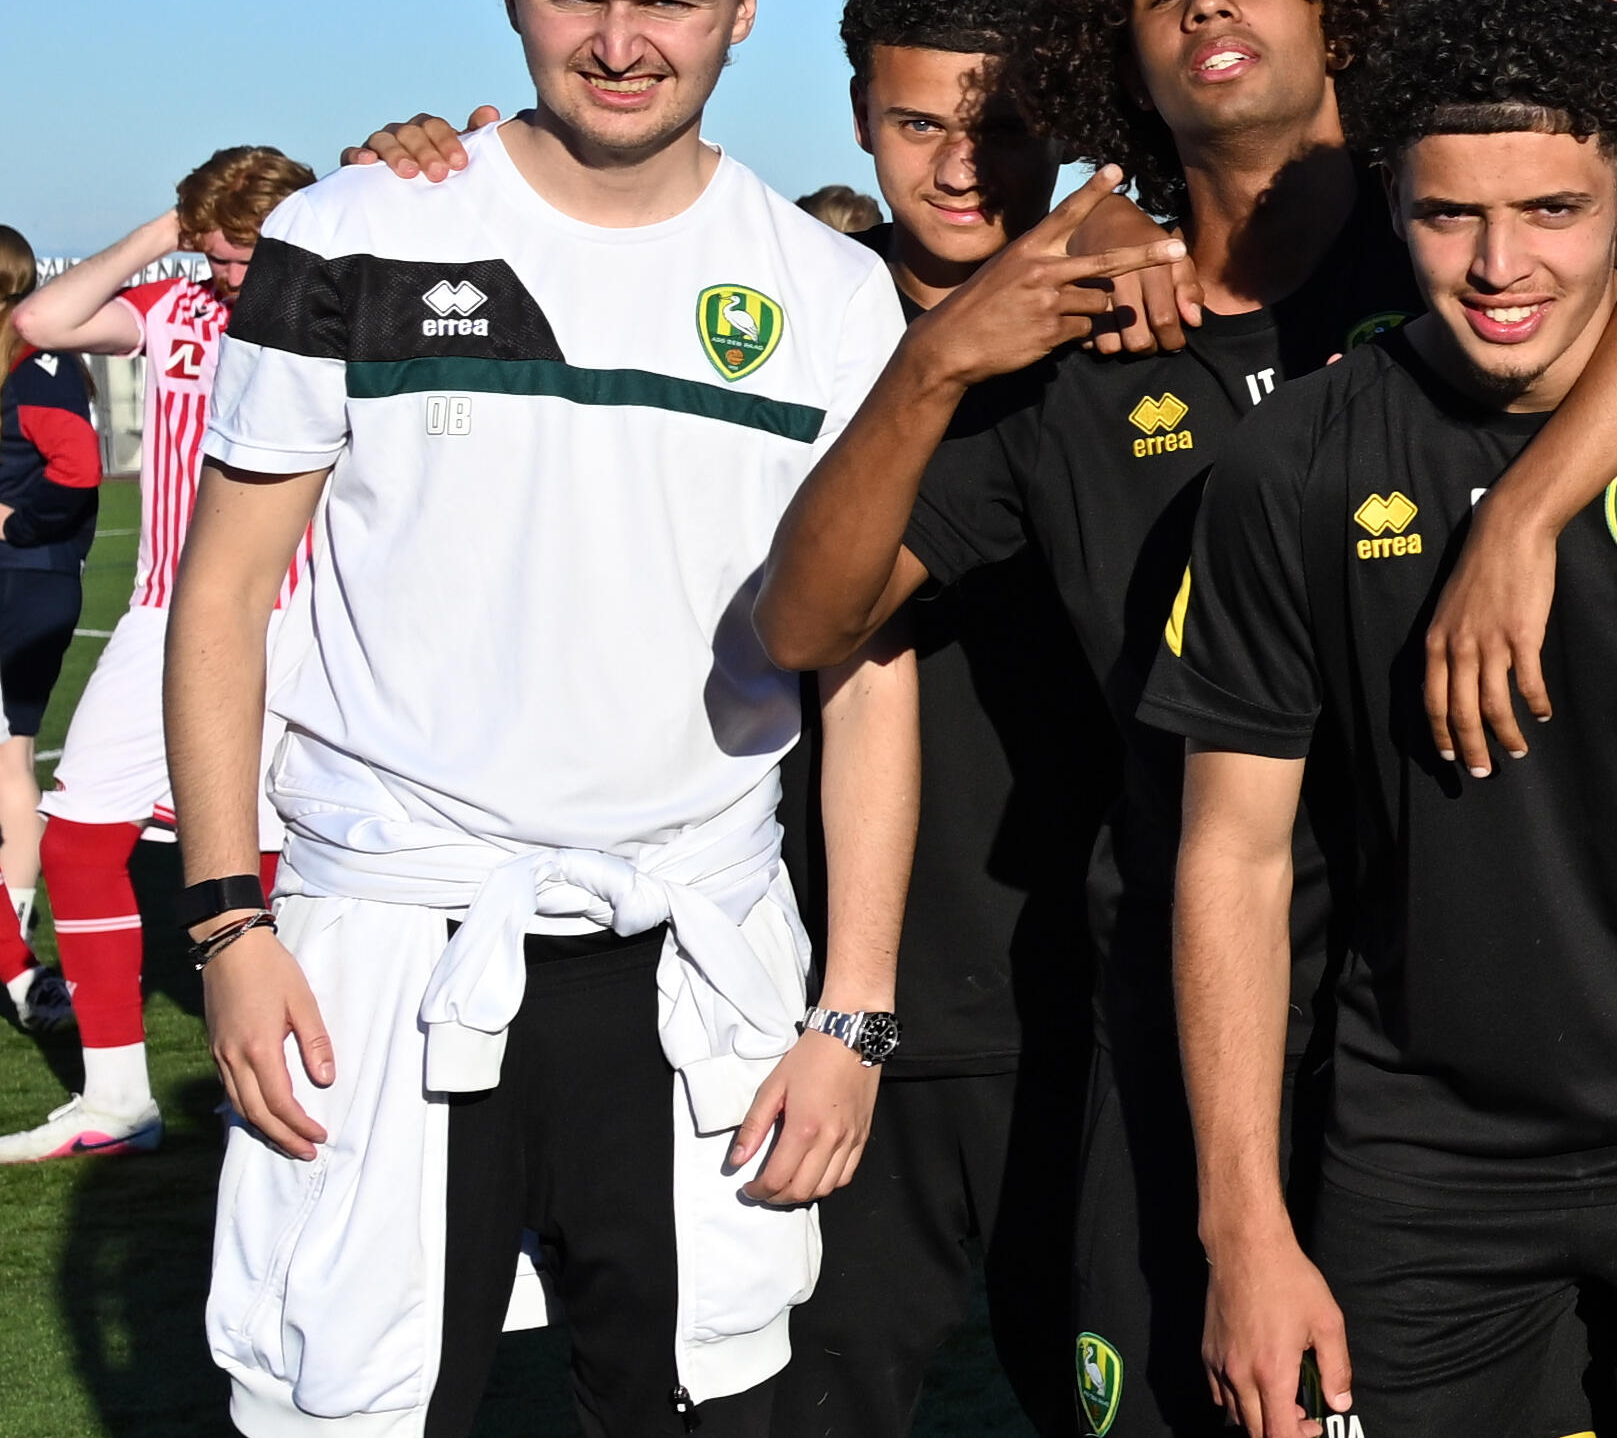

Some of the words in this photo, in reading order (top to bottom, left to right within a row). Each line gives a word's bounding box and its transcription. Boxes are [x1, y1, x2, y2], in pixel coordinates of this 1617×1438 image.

[422, 317, 490, 337] errea
[1133, 429, 1194, 458] errea
[1356, 533, 1423, 560] errea
